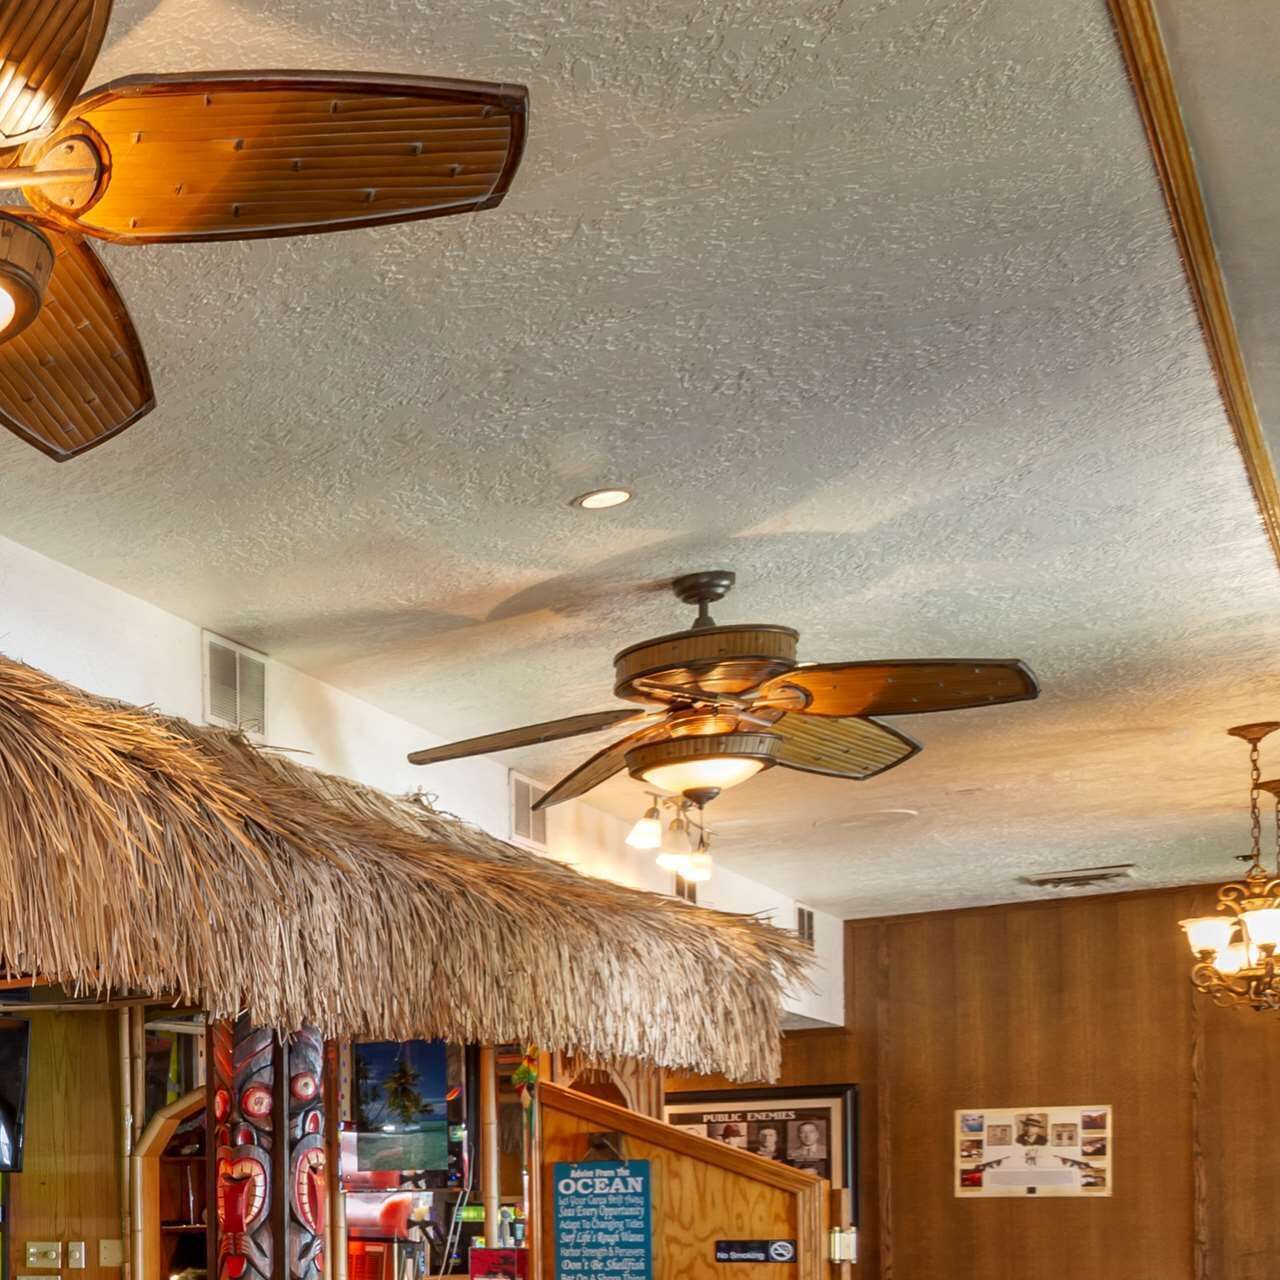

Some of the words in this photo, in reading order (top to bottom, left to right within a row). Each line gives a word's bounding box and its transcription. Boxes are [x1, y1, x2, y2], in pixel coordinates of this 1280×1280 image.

[703, 1113, 742, 1123] PUBLIC
[747, 1111, 796, 1121] ENEMIES
[558, 1177, 644, 1195] OCEAN
[716, 1251, 729, 1260] No
[729, 1251, 765, 1260] Smoking
